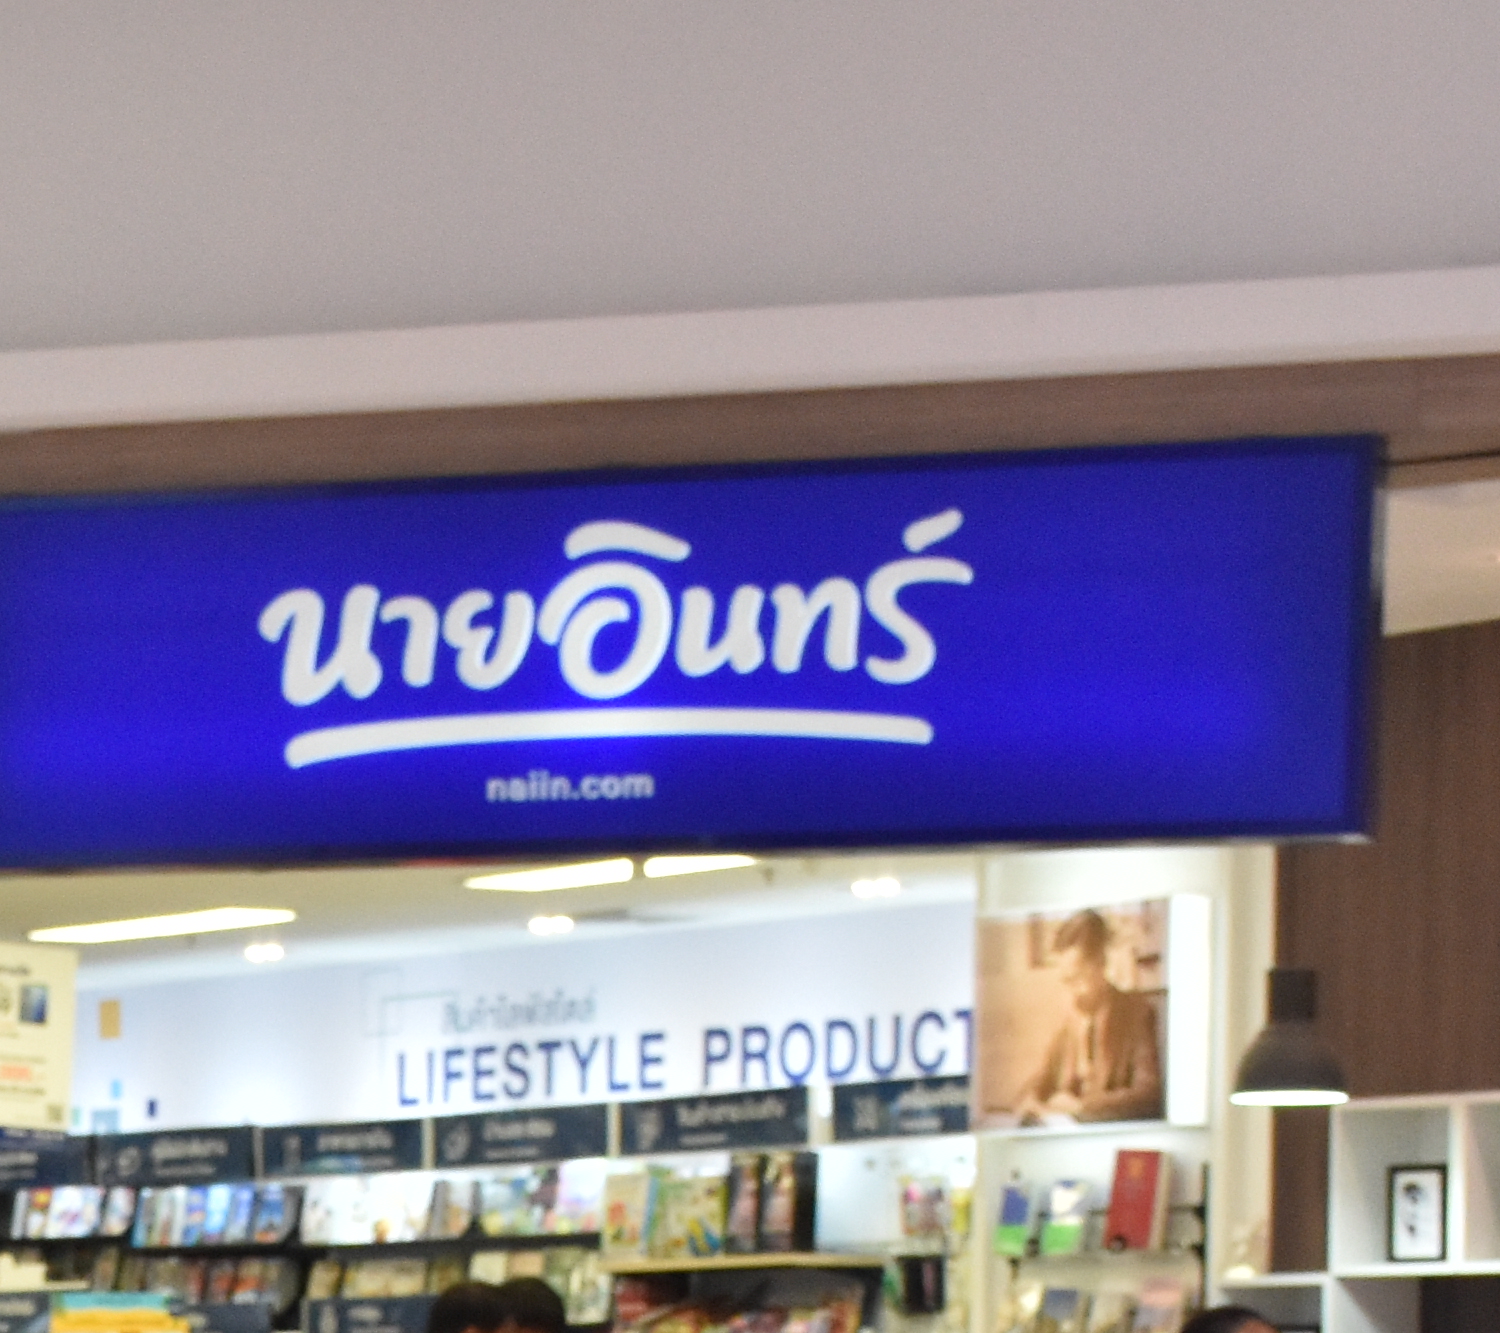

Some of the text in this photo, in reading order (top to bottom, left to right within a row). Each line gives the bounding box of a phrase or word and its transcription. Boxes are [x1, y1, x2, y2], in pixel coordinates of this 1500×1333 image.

[257, 507, 975, 708] นายอินทร์
[485, 768, 656, 804] naiin.com
[396, 1028, 669, 1107] LIFESTYLE
